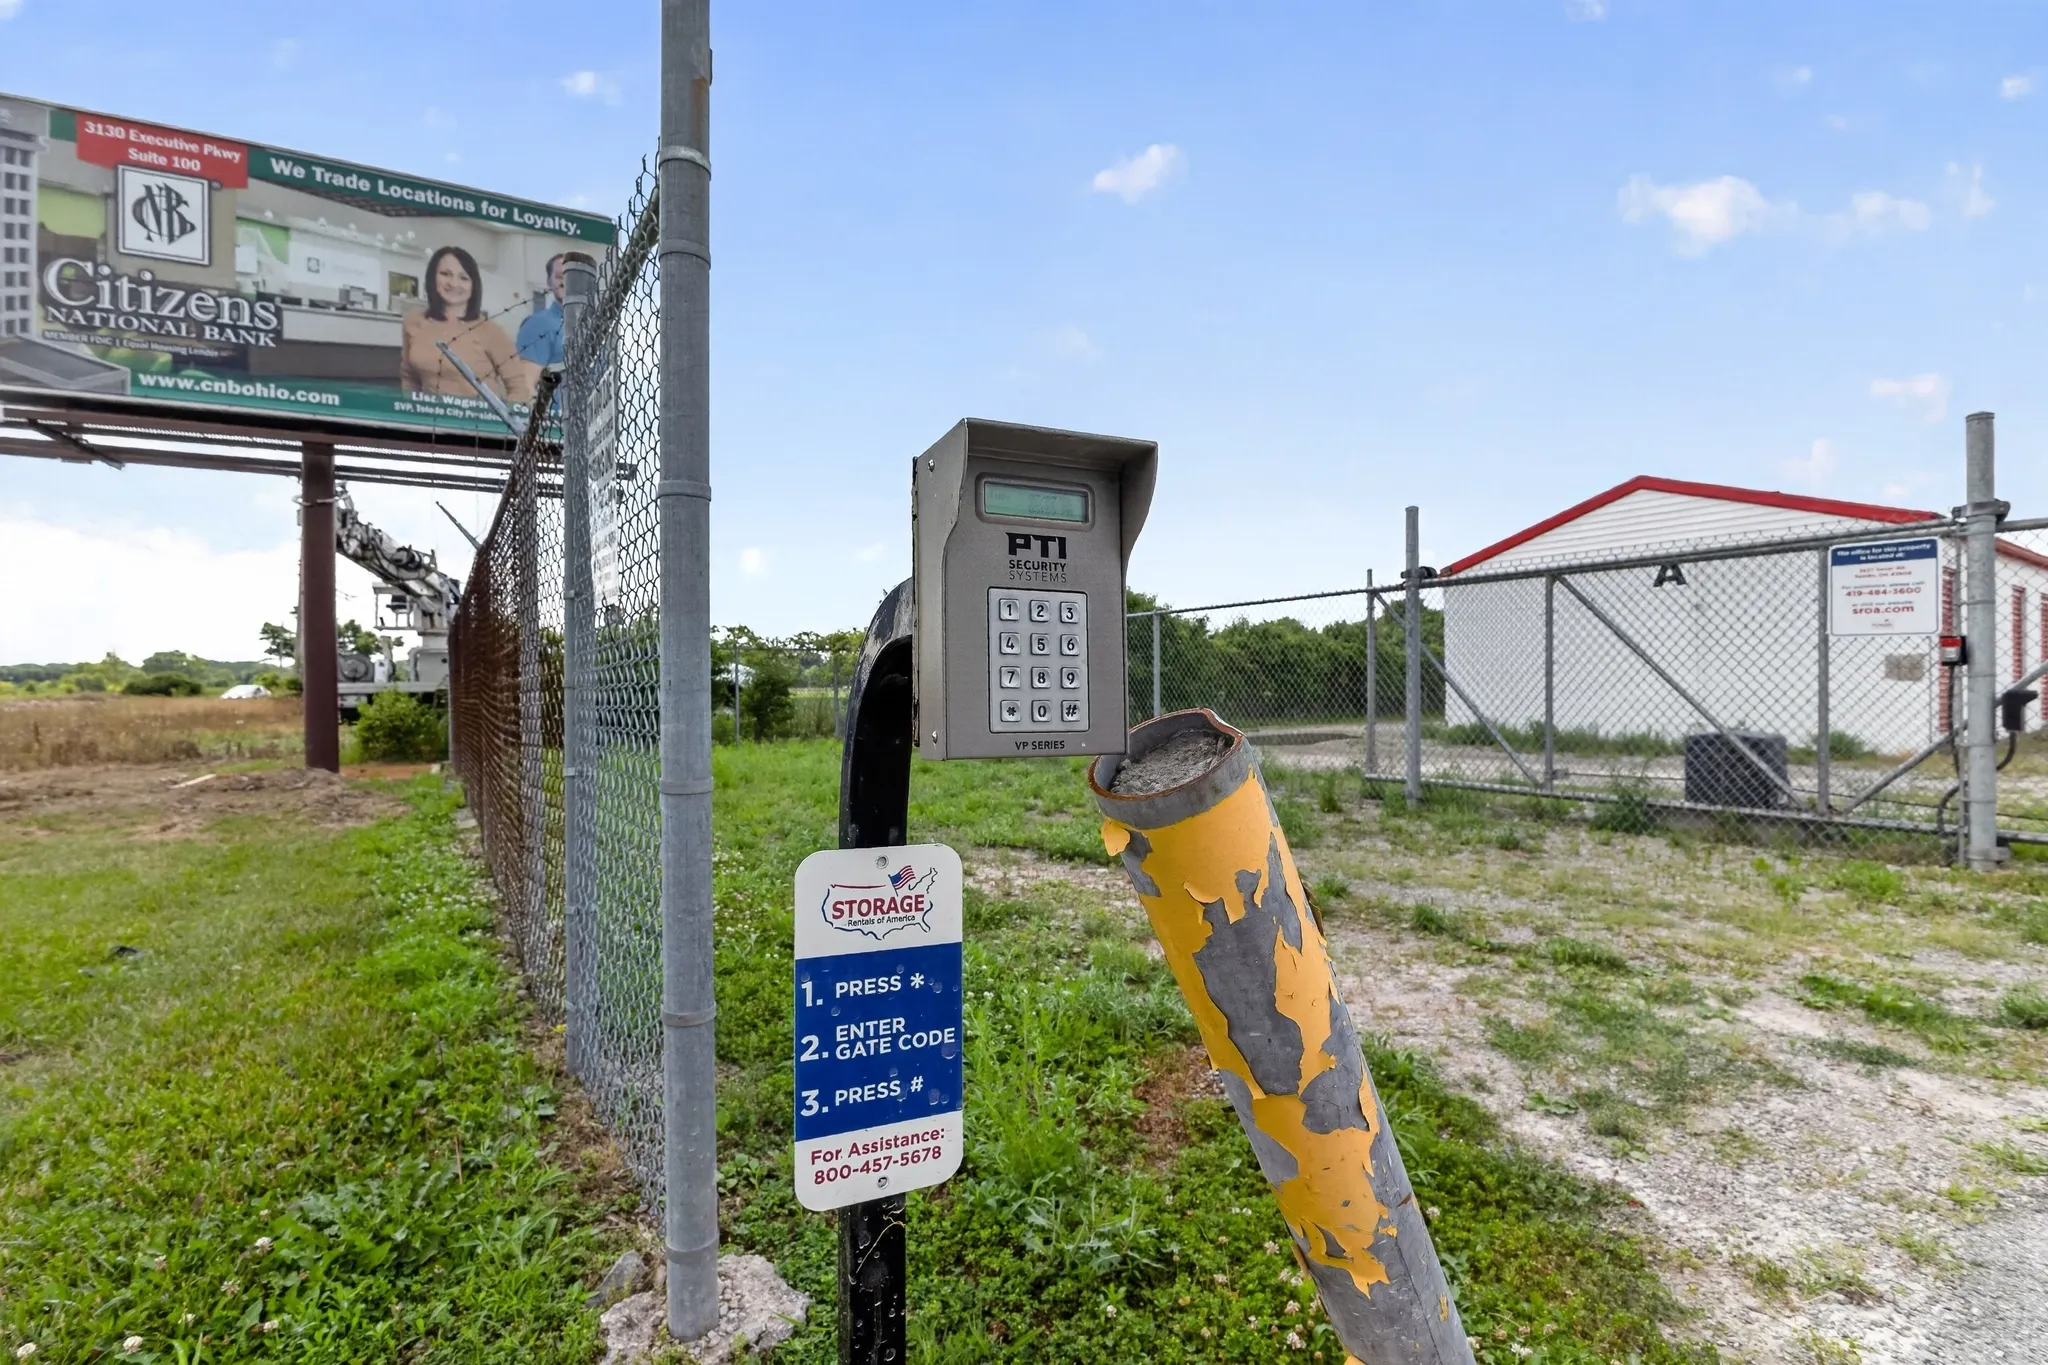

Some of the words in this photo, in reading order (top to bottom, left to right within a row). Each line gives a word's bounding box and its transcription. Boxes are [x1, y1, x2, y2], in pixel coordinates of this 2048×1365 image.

[84, 121, 126, 140] 3130
[129, 128, 200, 155] Executive
[203, 143, 242, 164] Pkwy
[128, 148, 168, 168] Suite
[172, 155, 201, 172] 100
[270, 157, 306, 178] We
[312, 166, 371, 193] Trade
[378, 179, 476, 213] Locations
[480, 201, 508, 219] for
[513, 208, 581, 236] Loyalty.
[44, 258, 279, 330] Citizens
[46, 306, 197, 338] NATIONAL
[203, 324, 276, 347] BANK
[138, 373, 340, 405] www.cnbohio.com
[1005, 532, 1067, 559] PTI
[1008, 559, 1067, 572] SECURITY
[1008, 570, 1067, 583] SYSTEMS
[1653, 563, 1687, 587] A
[1006, 603, 1012, 617] 1
[1036, 604, 1044, 618] 2
[1065, 607, 1073, 620] 3
[1851, 605, 1915, 615] sroa.com
[1005, 637, 1014, 650] 4
[1037, 638, 1045, 651] 5
[1066, 638, 1075, 651] 6
[1007, 671, 1015, 684] 7
[1037, 671, 1046, 685] 8
[1066, 672, 1075, 685] 9
[1037, 705, 1047, 717] 0
[1065, 704, 1077, 717] #
[1015, 741, 1030, 750] VP
[1031, 740, 1065, 750] SERIES
[832, 894, 924, 920] STORAGE
[848, 917, 875, 927] Rentals
[876, 916, 885, 924] of
[886, 914, 915, 924] America
[801, 980, 823, 1007] 1.
[835, 976, 902, 998] PRESS
[836, 1017, 906, 1041] ENTER
[800, 1034, 829, 1062] 2.
[835, 1037, 892, 1060] GATE
[898, 1027, 956, 1050] CODE
[800, 1089, 829, 1117] 3.
[835, 1080, 901, 1107] PRESS
[910, 1076, 924, 1093] #
[811, 1148, 842, 1165] For
[848, 1127, 945, 1159] Assistance:
[814, 1145, 942, 1185] 800-457-5678
